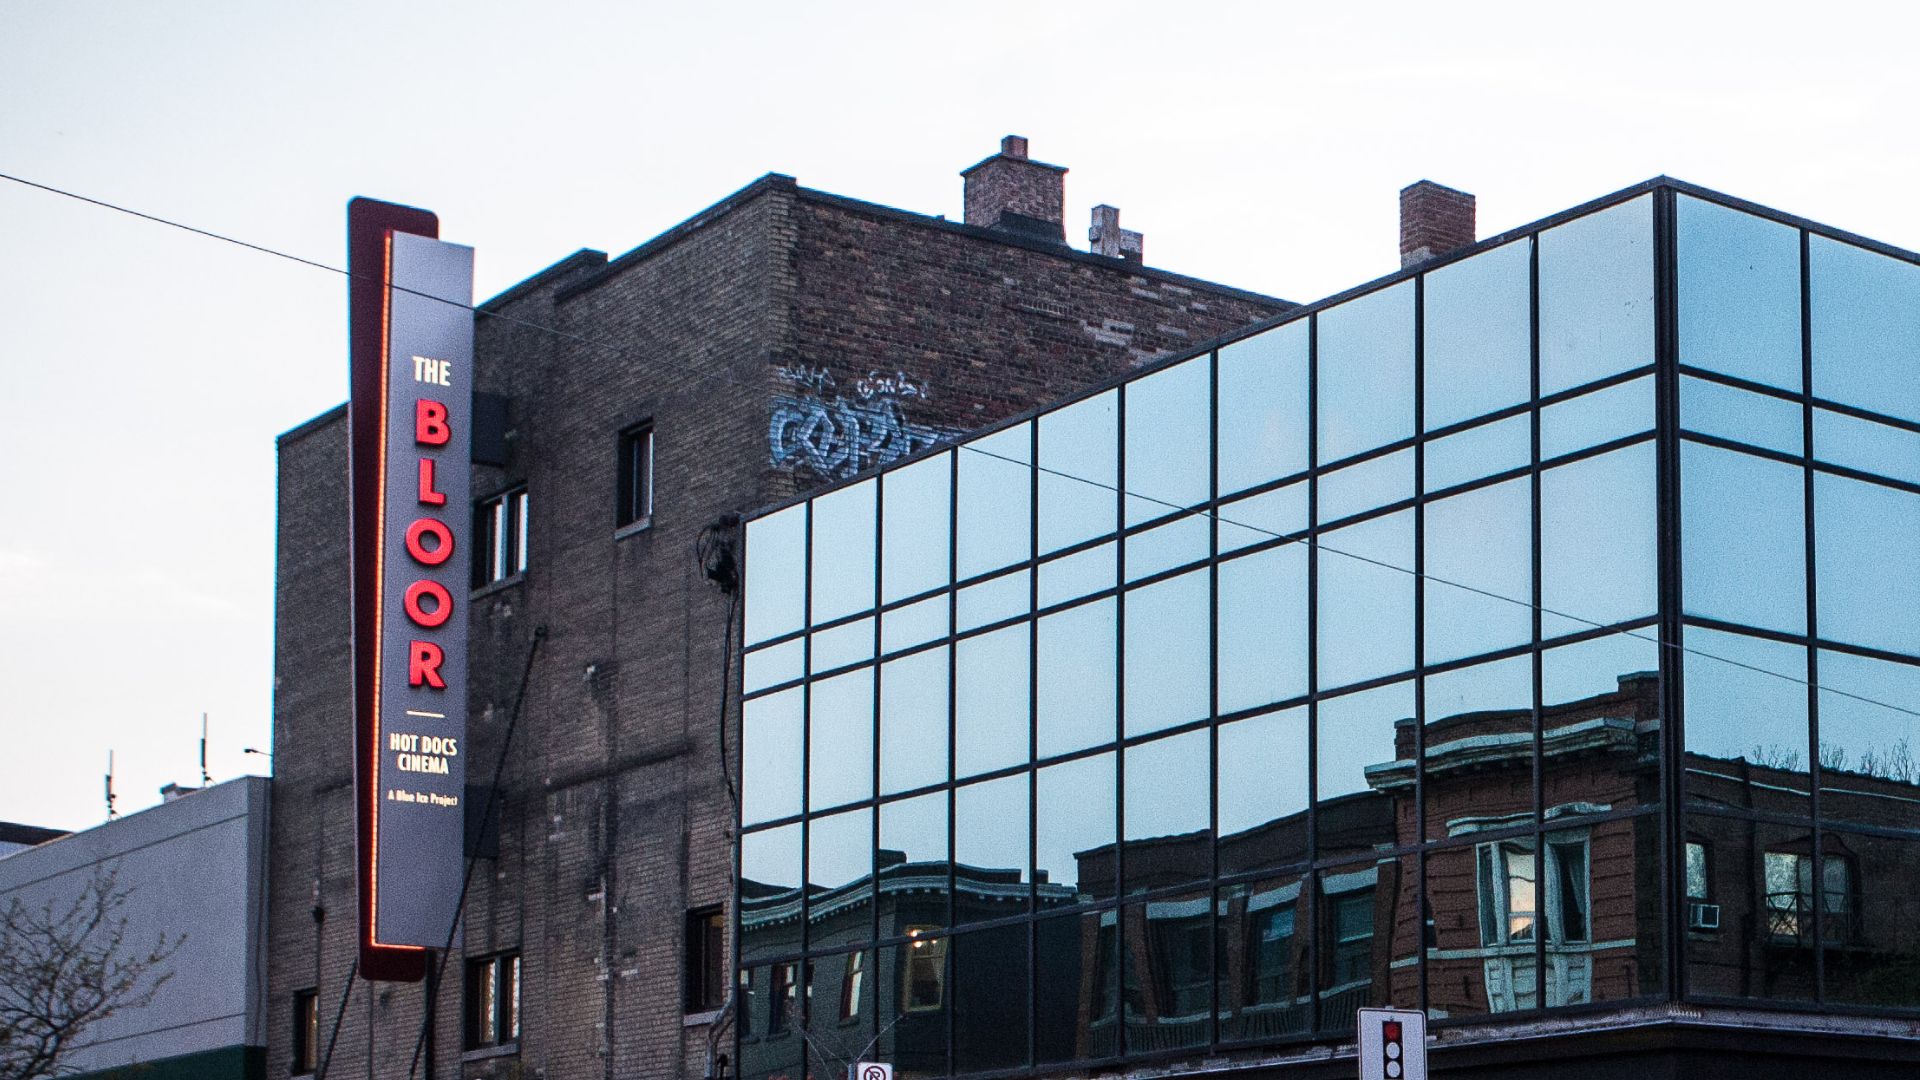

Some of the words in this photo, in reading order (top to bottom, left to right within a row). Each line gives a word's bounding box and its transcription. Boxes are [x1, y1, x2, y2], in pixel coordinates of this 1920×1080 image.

[412, 355, 451, 386] THE
[404, 399, 455, 689] BLOOR
[390, 733, 418, 752] HOT
[422, 736, 458, 756] DOCS
[397, 753, 449, 774] CINEMA
[387, 789, 395, 800] A
[396, 789, 415, 802] Blue
[416, 792, 429, 803] Ice
[430, 793, 458, 807] Project
